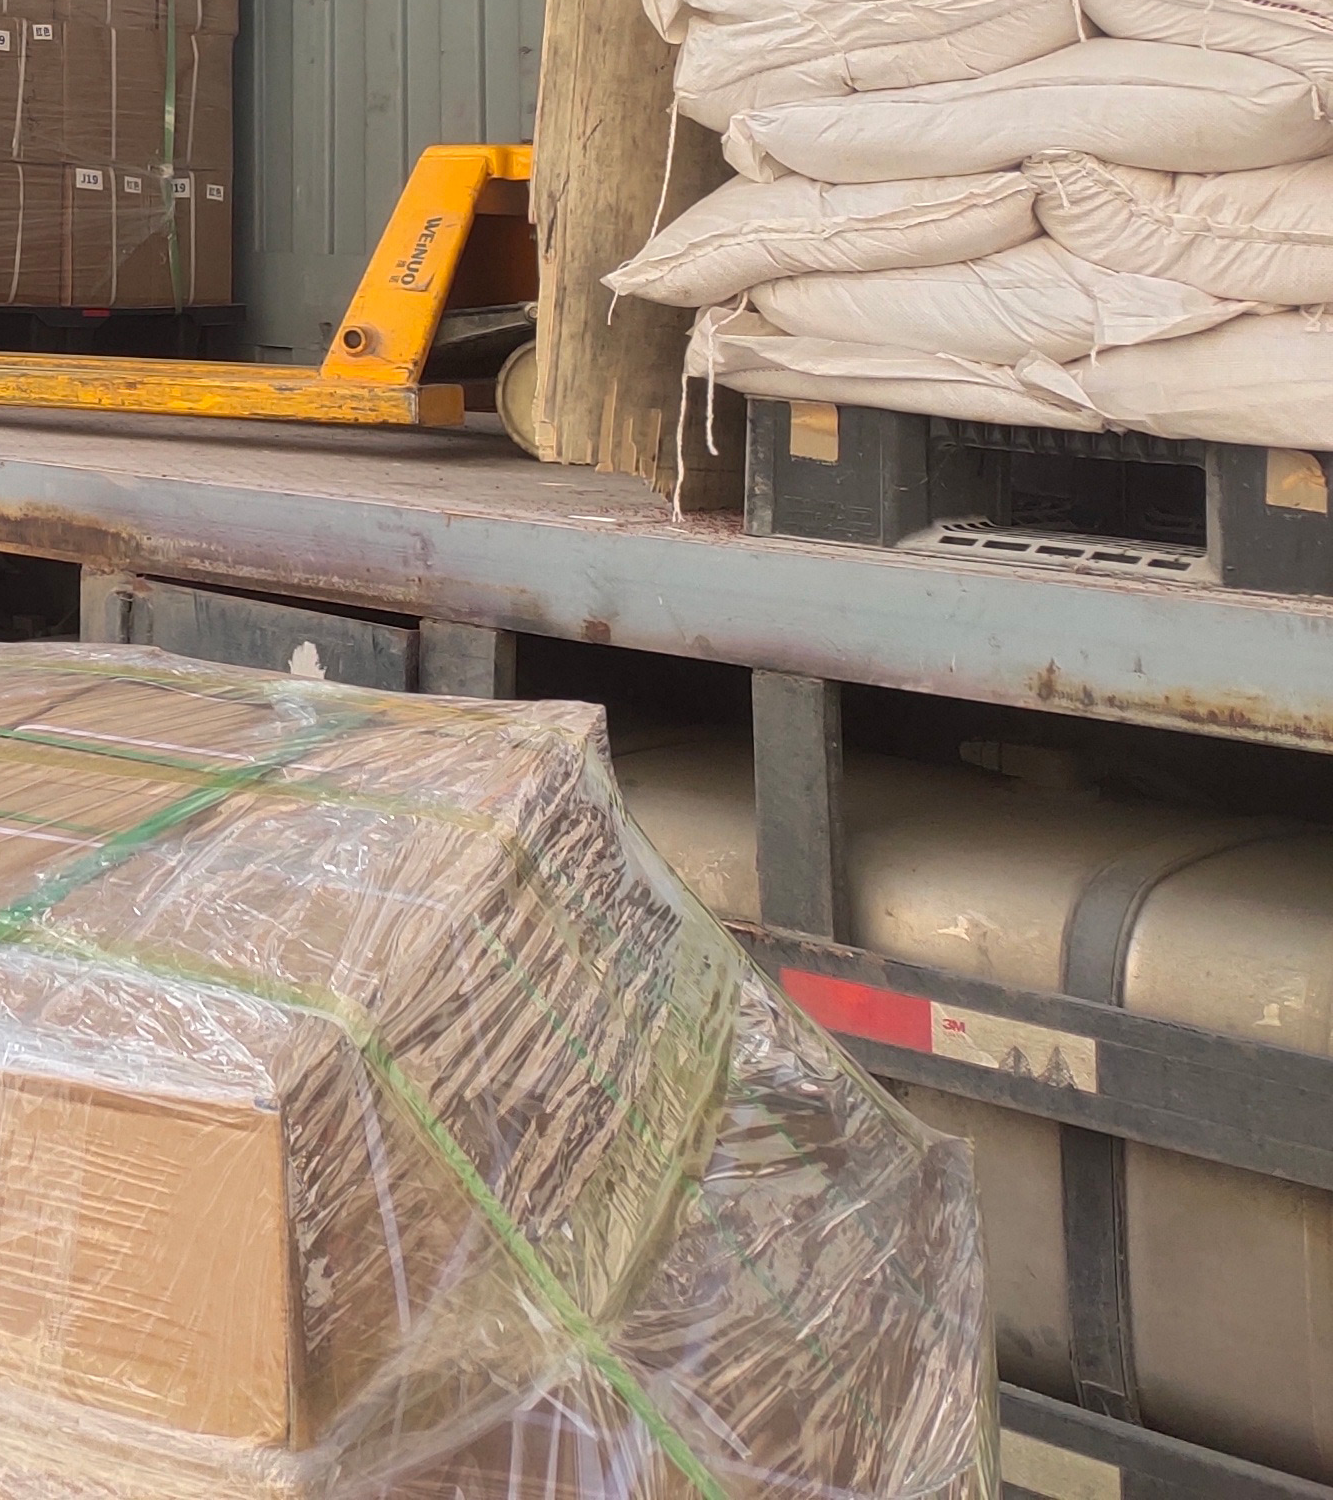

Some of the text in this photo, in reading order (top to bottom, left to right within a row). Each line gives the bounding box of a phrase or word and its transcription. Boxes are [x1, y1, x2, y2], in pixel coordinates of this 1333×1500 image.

[35, 27, 50, 37] 红色
[81, 173, 99, 185] J19
[942, 1018, 967, 1033] 3M
